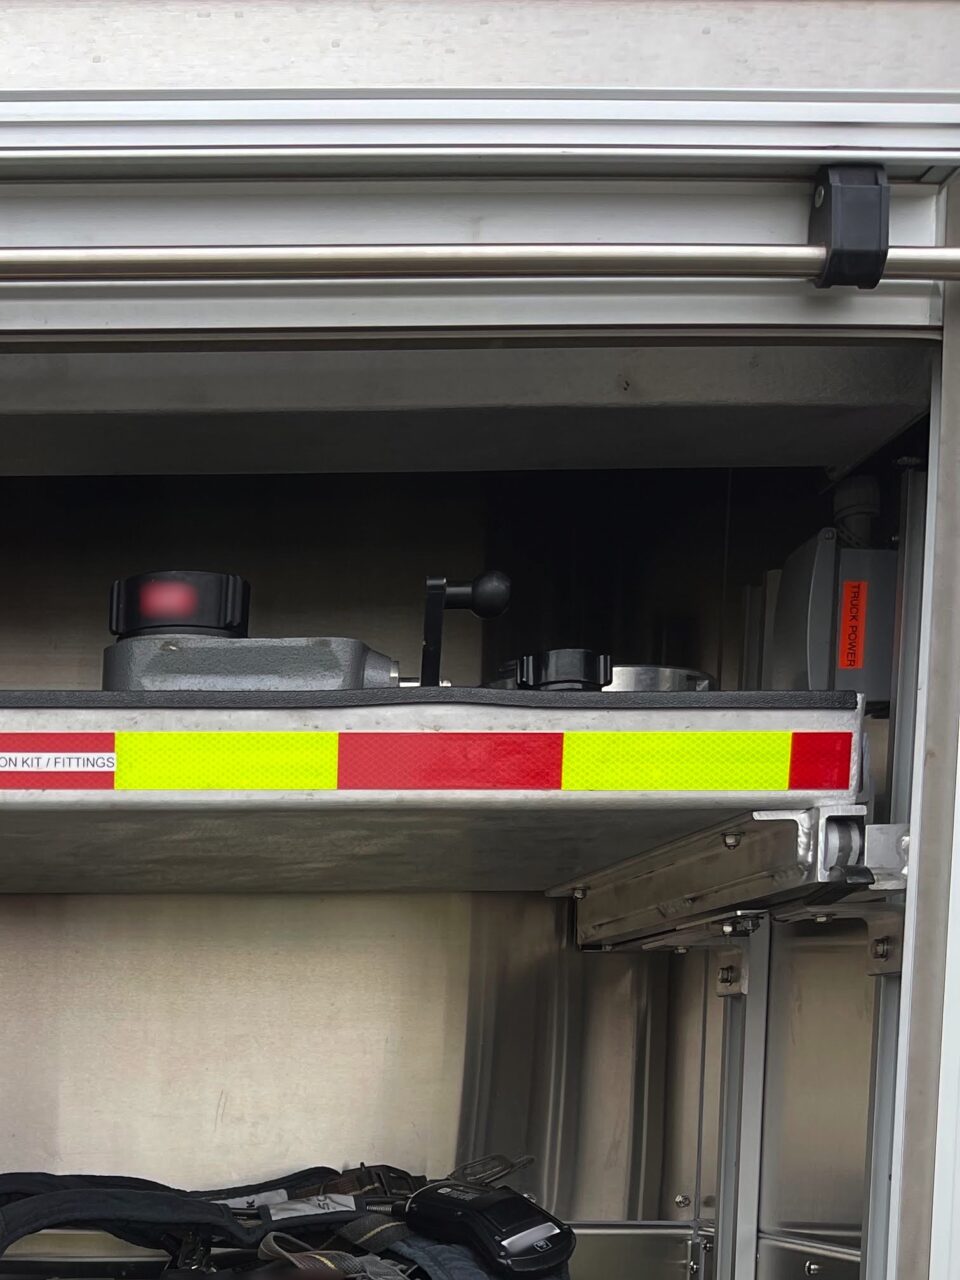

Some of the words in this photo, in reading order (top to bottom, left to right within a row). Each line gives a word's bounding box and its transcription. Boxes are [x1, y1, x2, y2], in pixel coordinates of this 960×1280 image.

[849, 583, 860, 622] TRUCK
[846, 626, 857, 668] POWER
[21, 757, 42, 769] KIT
[53, 757, 115, 769] FITTINGS
